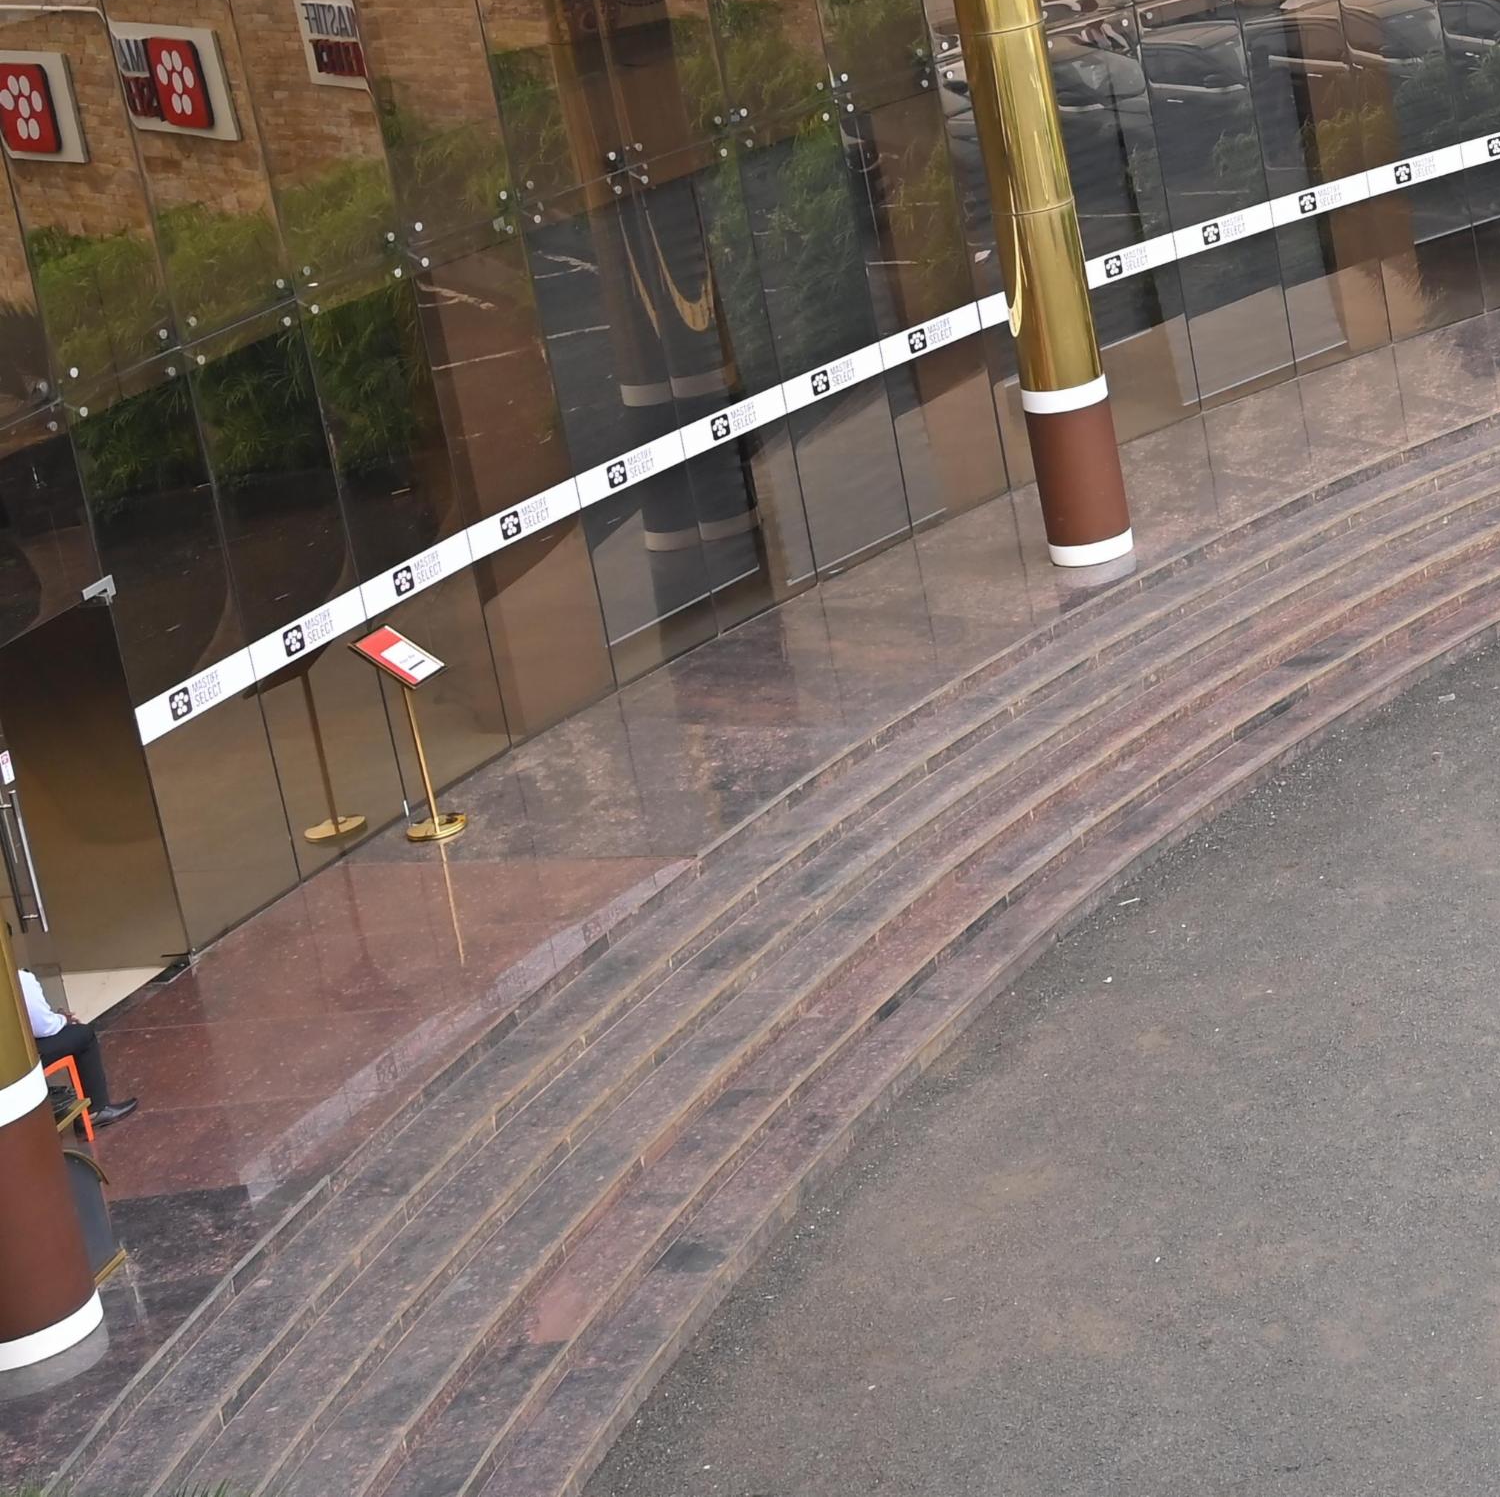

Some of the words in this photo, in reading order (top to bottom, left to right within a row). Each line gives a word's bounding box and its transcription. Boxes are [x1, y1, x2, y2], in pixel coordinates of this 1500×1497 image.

[929, 327, 952, 345] SELECT
[832, 368, 855, 387] SELECT
[730, 402, 754, 419] MASTIFF
[733, 412, 757, 431] SELECT
[630, 458, 654, 479] SELECT
[521, 497, 546, 516] MASTIFF
[524, 507, 550, 529] SELECT
[414, 551, 439, 571] MASTIFF
[417, 561, 442, 584] SELECT
[305, 609, 331, 631] MASTIFF
[307, 620, 334, 644] SELECT
[192, 669, 218, 693] MASTIFF
[194, 681, 222, 707] SELECT
